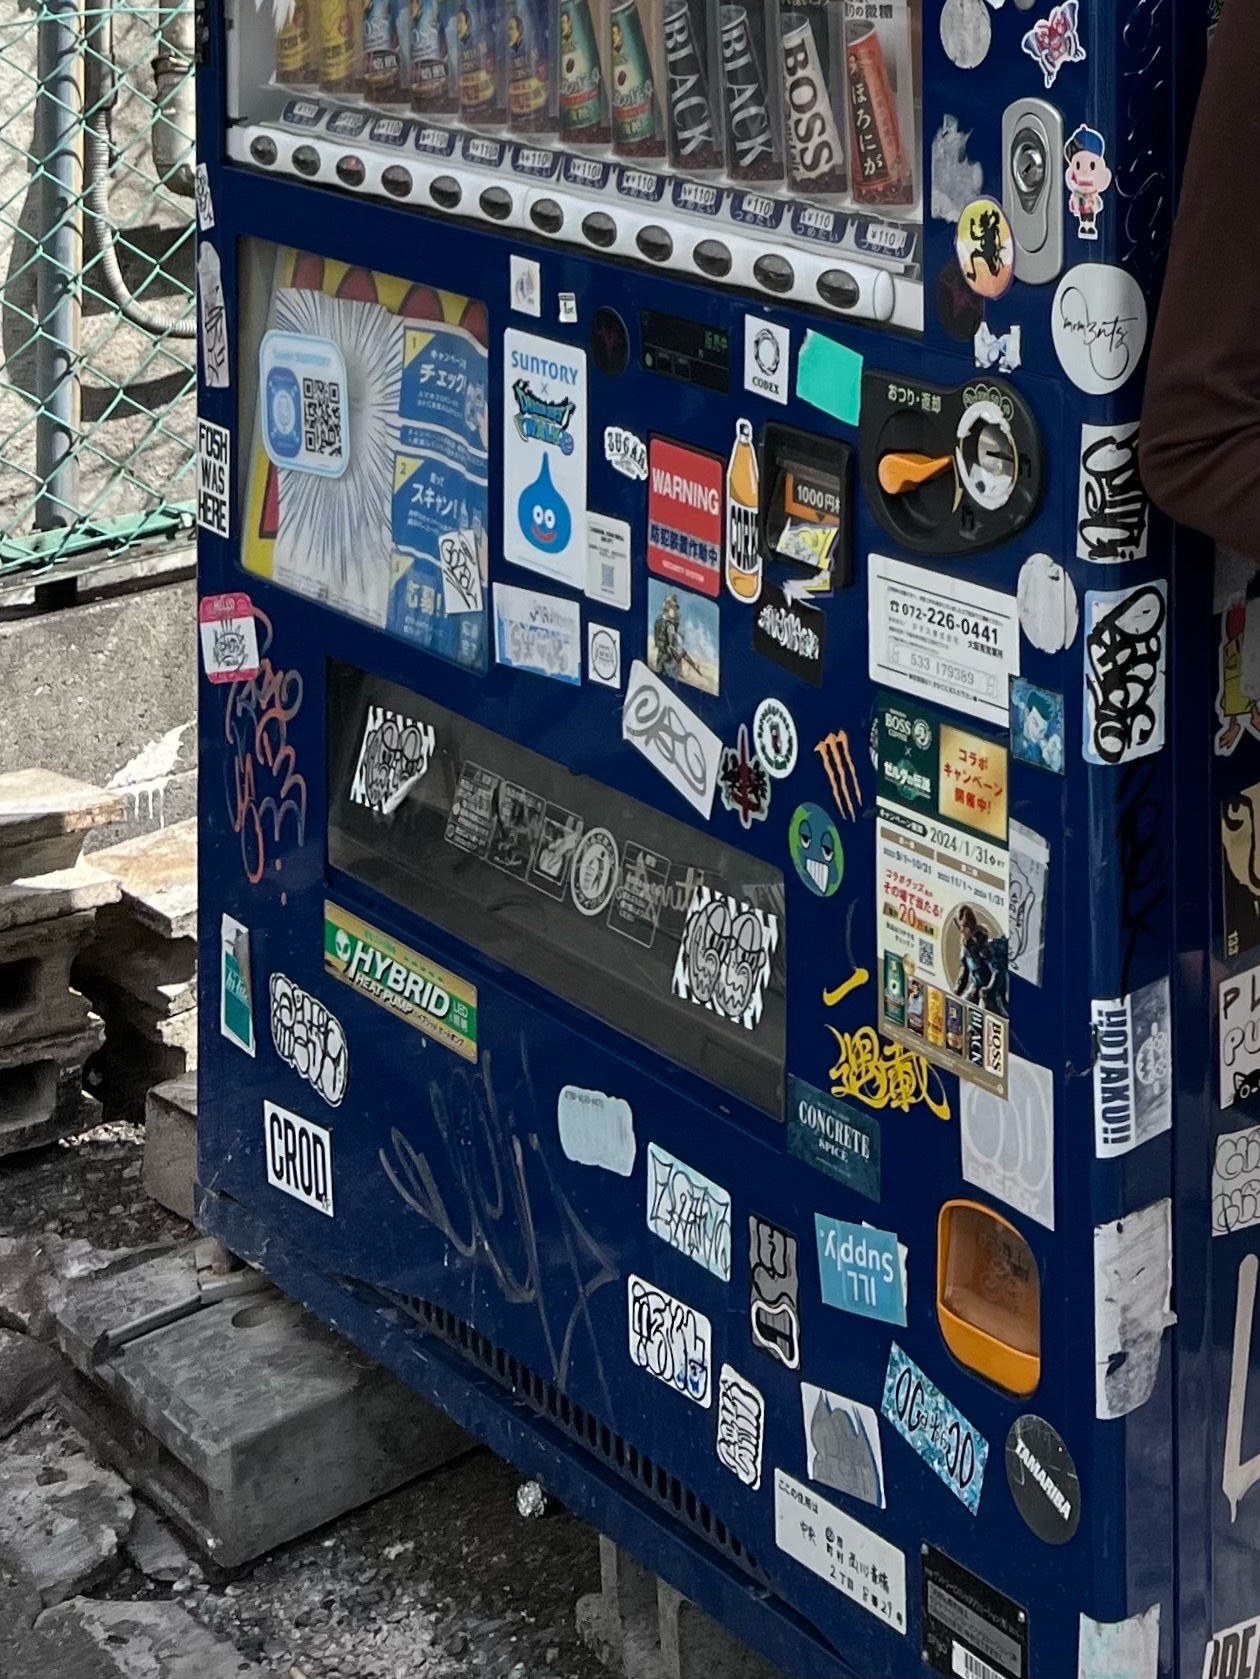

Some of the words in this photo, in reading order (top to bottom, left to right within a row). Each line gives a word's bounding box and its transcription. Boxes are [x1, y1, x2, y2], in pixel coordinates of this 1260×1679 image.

[663, 19, 715, 157] BLACK
[720, 23, 776, 168] BLACK
[783, 38, 834, 170] BOSS
[850, 82, 884, 176] ほろにが
[747, 199, 771, 214] ¥110
[806, 211, 831, 227] ¥110
[871, 230, 896, 245] ¥110
[511, 349, 579, 387] SUNTORY
[751, 374, 781, 396] CODEX
[886, 383, 943, 415] おつり・返却
[200, 465, 226, 495] WAS
[652, 466, 720, 517] WARNING
[198, 488, 228, 534] HERE
[650, 523, 719, 564] 防犯装置作動中
[901, 602, 999, 646] 072-226-0441
[910, 653, 931, 670] 533
[935, 660, 975, 686] 179389
[884, 712, 912, 736] BOSS
[958, 748, 989, 771] コラボ
[943, 762, 1004, 797] キャンペーン
[954, 787, 992, 815] 開催中!
[347, 940, 451, 1018] HYBRID
[354, 972, 384, 998] HEAT
[381, 989, 414, 1016] PUMP
[989, 1021, 1002, 1071] BOSS
[799, 1099, 871, 1163] CONCRETE
[818, 1139, 850, 1165] SPICE
[848, 1270, 877, 1307] ILL
[1014, 1440, 1073, 1522] TAMARIBA
